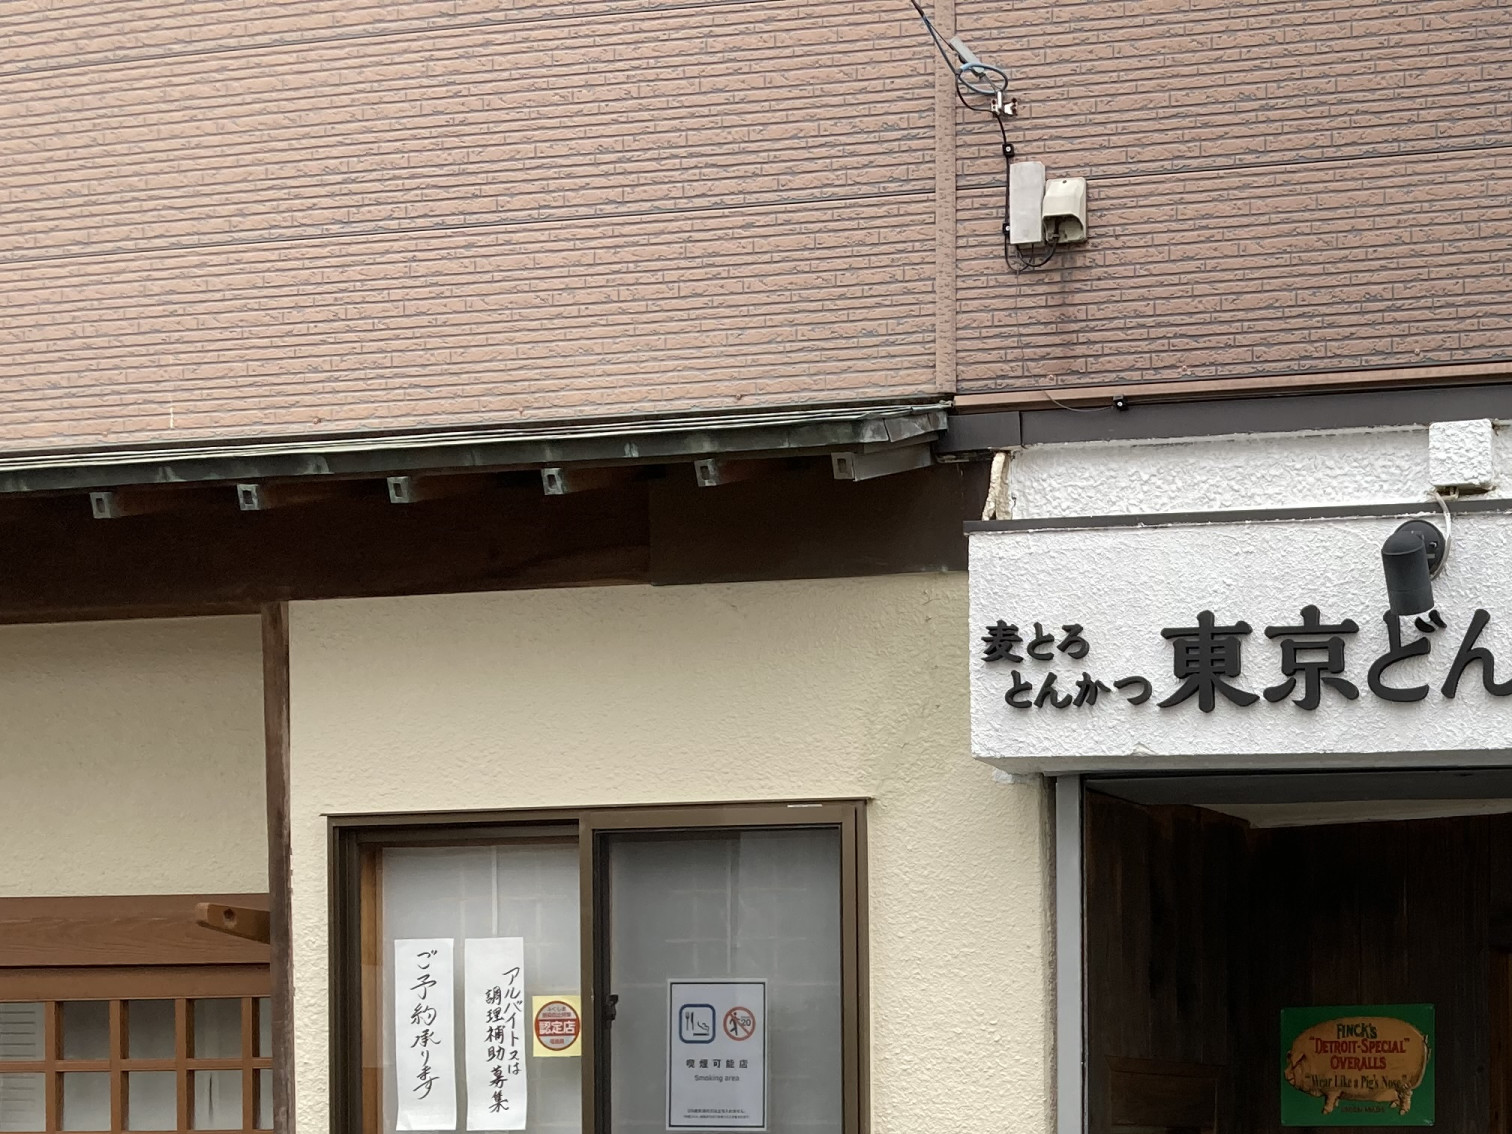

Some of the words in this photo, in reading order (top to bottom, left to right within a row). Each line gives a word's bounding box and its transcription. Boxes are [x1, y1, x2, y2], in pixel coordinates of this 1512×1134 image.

[981, 619, 1090, 663] 麦とろ
[1005, 670, 1152, 708] とんかつ
[410, 950, 441, 1099] ご予約承ります
[539, 1021, 576, 1035] 認定店
[485, 987, 510, 1113] 調理補助募集
[686, 1059, 748, 1069] 喫煙可能店
[694, 1075, 723, 1083] Smoking
[1334, 1075, 1351, 1088] Like
[1354, 1080, 1358, 1088] a
